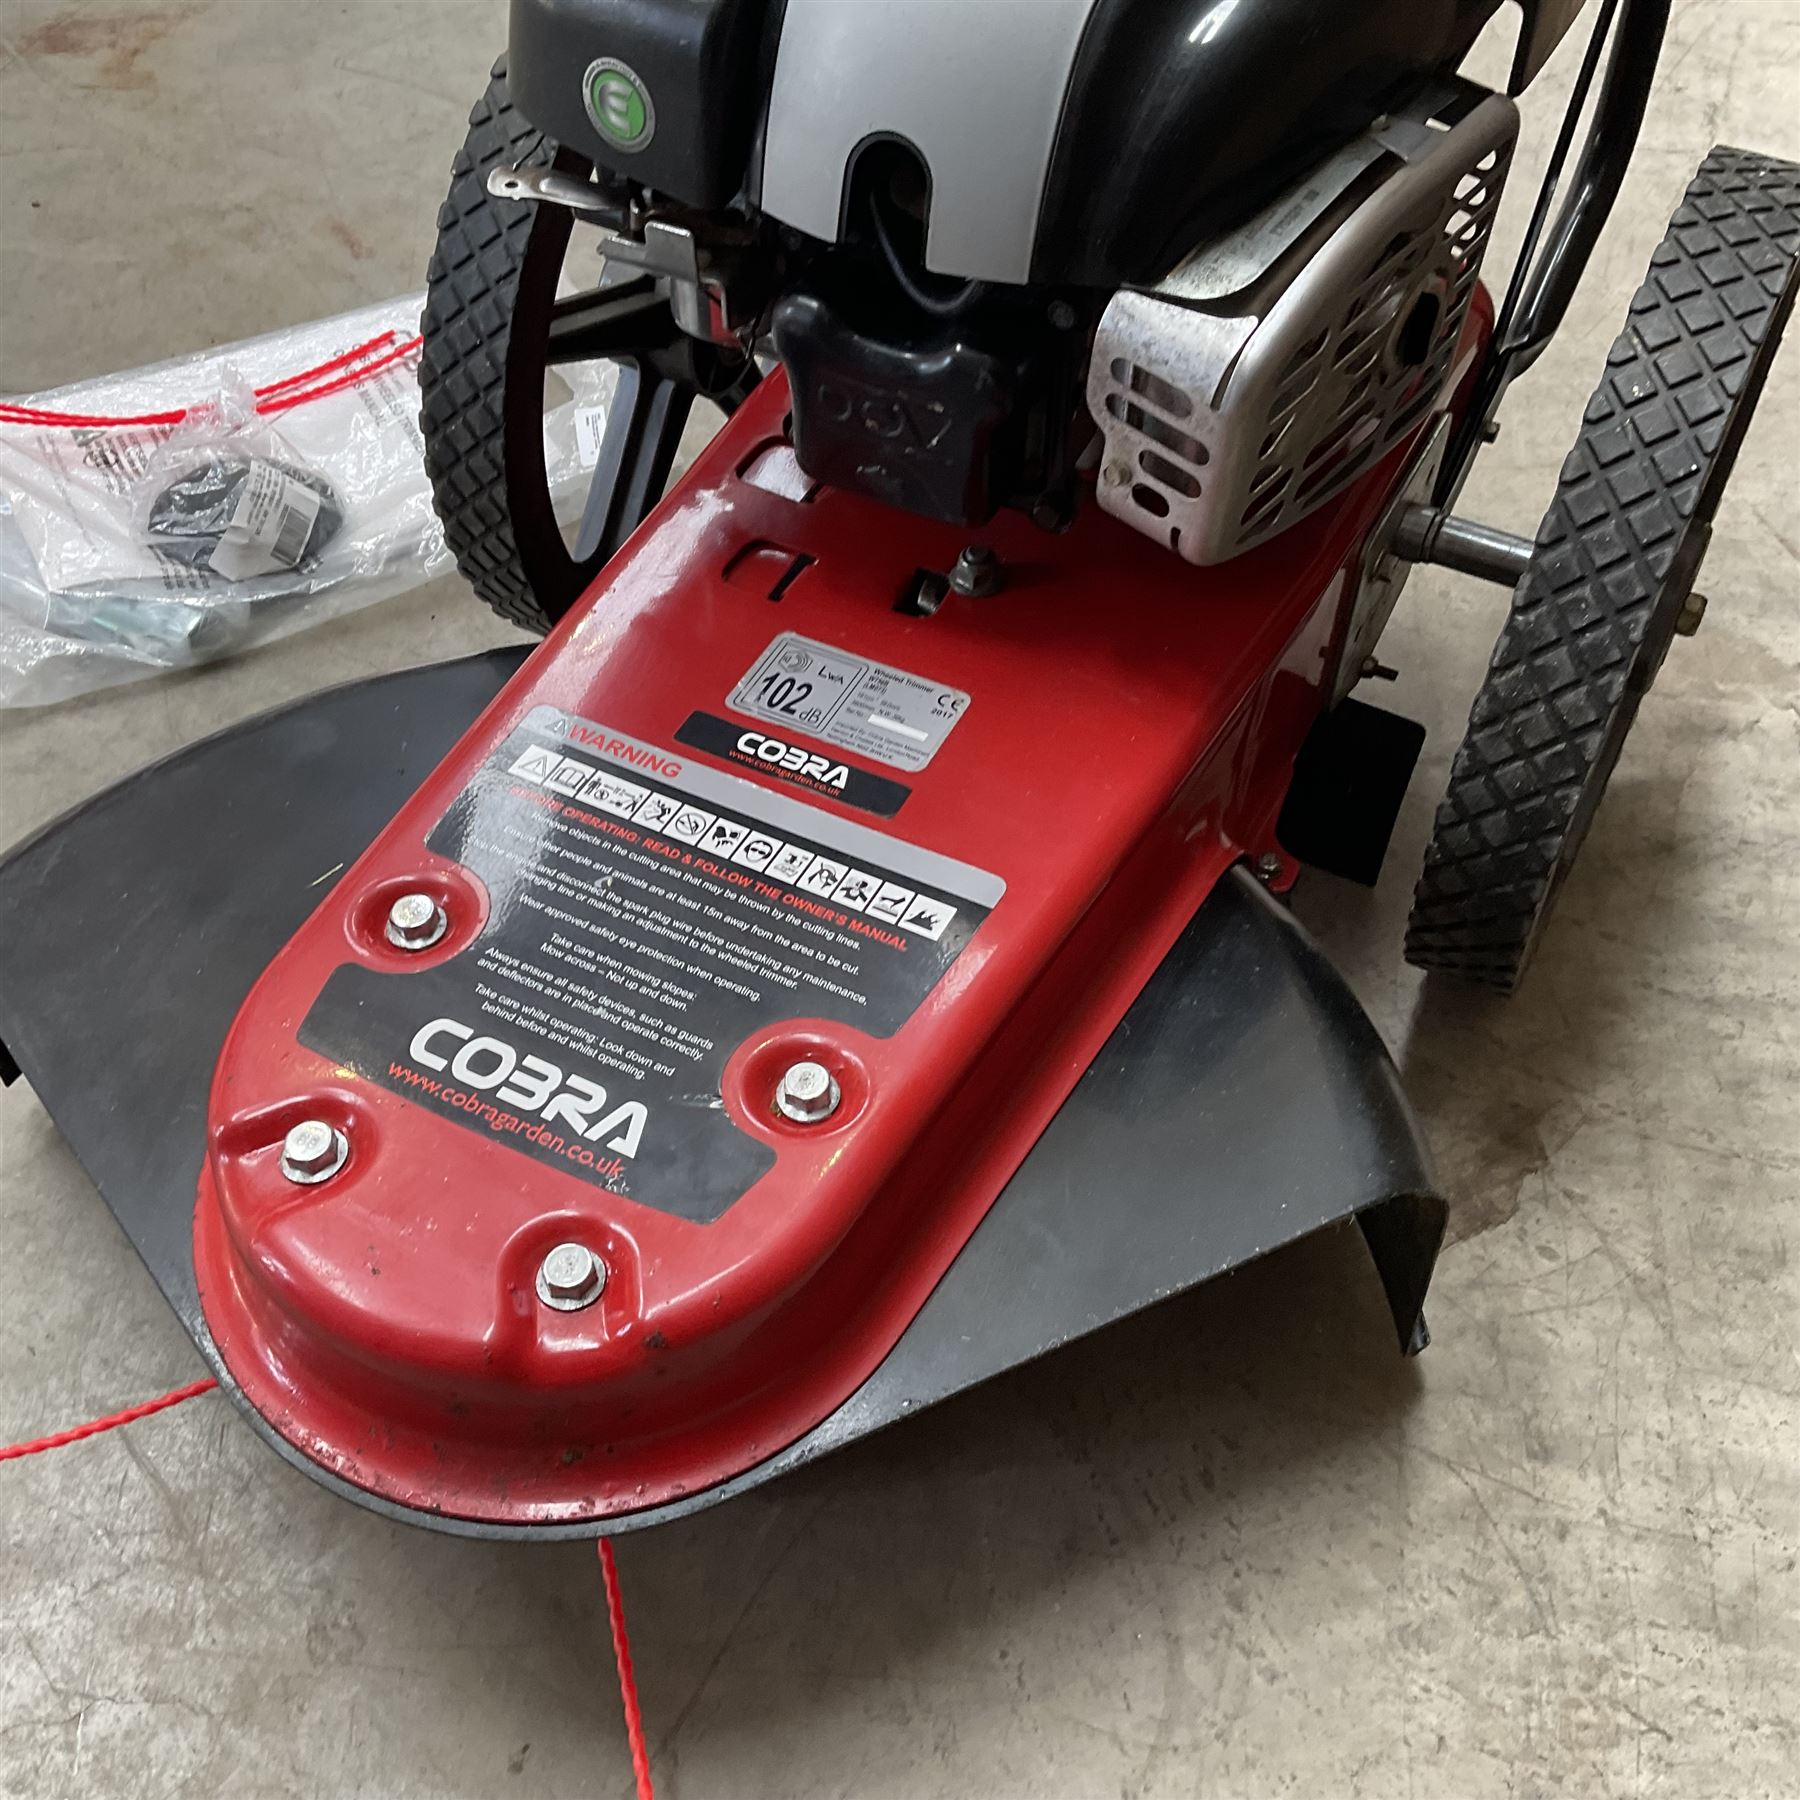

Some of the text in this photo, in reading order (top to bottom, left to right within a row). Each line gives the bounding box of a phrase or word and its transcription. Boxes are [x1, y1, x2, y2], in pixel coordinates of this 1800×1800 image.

[762, 672, 814, 715] 102
[570, 724, 682, 777] WARNING
[728, 749, 841, 798] www.cobragarden.co.uk
[736, 732, 849, 791] COBRA
[538, 865, 557, 876] and
[556, 870, 607, 896] disconnect
[605, 890, 622, 903] the
[622, 899, 650, 914] spark
[647, 910, 671, 925] plug
[671, 919, 693, 932] wire
[692, 926, 725, 945] before
[724, 941, 782, 970] undertaking
[782, 965, 802, 979] any
[558, 848, 592, 866] people
[592, 862, 612, 874] and
[611, 869, 648, 889] animals
[648, 884, 665, 896] are
[665, 891, 678, 900] at
[676, 894, 703, 910] least
[701, 904, 723, 919] 15m
[723, 915, 750, 932] away
[749, 924, 773, 940] from
[772, 933, 790, 946] the
[790, 942, 814, 956] area
[813, 950, 826, 961] to
[825, 954, 841, 967] be
[840, 963, 860, 975] cut.
[563, 806, 640, 842] OPERATING:
[642, 838, 680, 858] READ
[681, 853, 693, 863] &
[693, 858, 751, 886] FOLLOW
[753, 881, 781, 898] THE
[782, 894, 847, 924] OWNER'S
[847, 920, 910, 950] MANUAL
[568, 827, 601, 844] objects
[601, 839, 612, 849] in
[611, 843, 628, 855] the
[628, 851, 659, 870] cutting
[660, 864, 682, 877] area
[682, 872, 704, 885] that
[701, 881, 723, 896] may
[723, 888, 737, 899] be
[737, 894, 770, 913] thrown
[770, 907, 784, 920] by
[784, 913, 802, 925] the
[801, 921, 835, 940] cutting
[834, 933, 860, 950] lines.
[518, 893, 545, 910] Wear
[544, 906, 590, 929] approved
[588, 924, 618, 942] safety
[618, 936, 637, 949] eye
[635, 944, 686, 969] protection
[685, 964, 713, 980] when
[539, 941, 564, 958] Mow
[564, 954, 597, 972] across
[605, 969, 626, 983] Not
[623, 979, 639, 990] up
[639, 985, 660, 998] and
[659, 992, 687, 1011] down.
[549, 931, 698, 1001] Take care when mowing slopes:
[556, 883, 575, 896] line
[575, 893, 587, 901] or
[586, 897, 621, 917] making
[621, 912, 635, 922] an
[635, 918, 690, 943] adjustment
[687, 938, 700, 948] to
[699, 942, 716, 955] the
[716, 951, 760, 972] wheeled
[758, 966, 797, 989] trimmer.
[473, 982, 676, 1076] Take care whilst operating: Look down and
[477, 957, 498, 971] and
[496, 964, 544, 991] deflectors
[544, 986, 562, 998] are
[561, 992, 572, 1003] in
[620, 1019, 660, 1040] operate
[659, 1036, 703, 1061] correctly.
[481, 1000, 645, 1079] behind before and whilst operating.
[484, 945, 714, 1049] Always ensure all safety devices, such as guards
[388, 1060, 626, 1180] www.cobragarden.co.uk
[409, 1018, 649, 1159] COBRA
